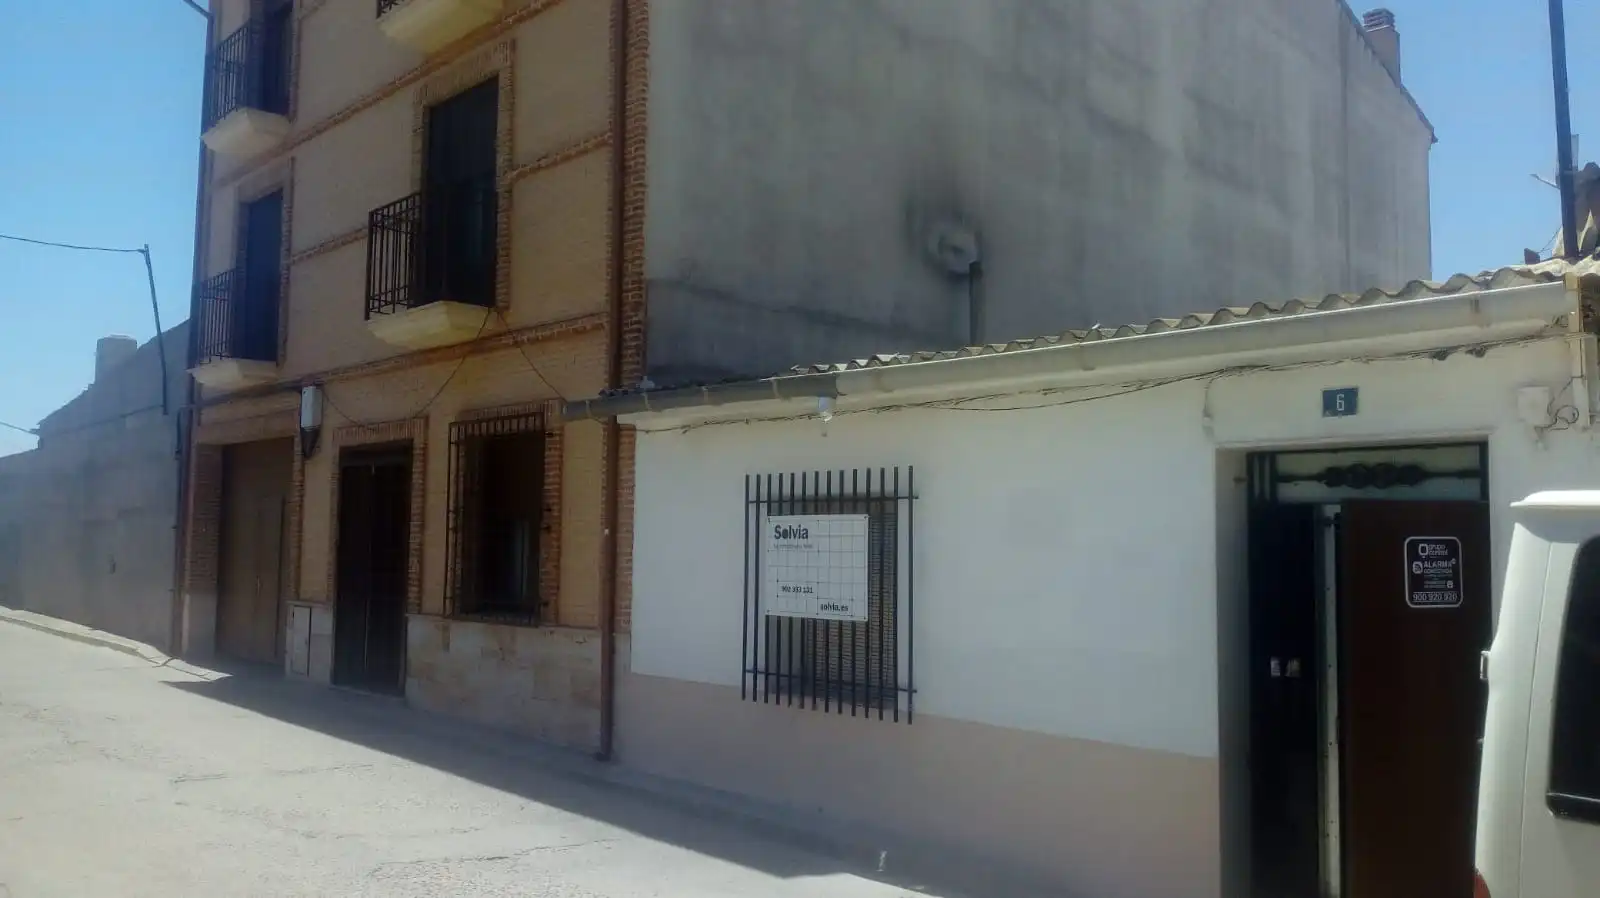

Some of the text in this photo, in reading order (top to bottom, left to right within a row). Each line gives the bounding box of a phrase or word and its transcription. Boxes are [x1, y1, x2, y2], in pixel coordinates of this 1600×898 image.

[1336, 393, 1345, 411] 6
[774, 524, 809, 540] Solvia
[1423, 560, 1453, 569] ALARMA
[1412, 593, 1427, 601] 900
[1428, 593, 1443, 601] 920
[820, 602, 849, 612] solvia.es
